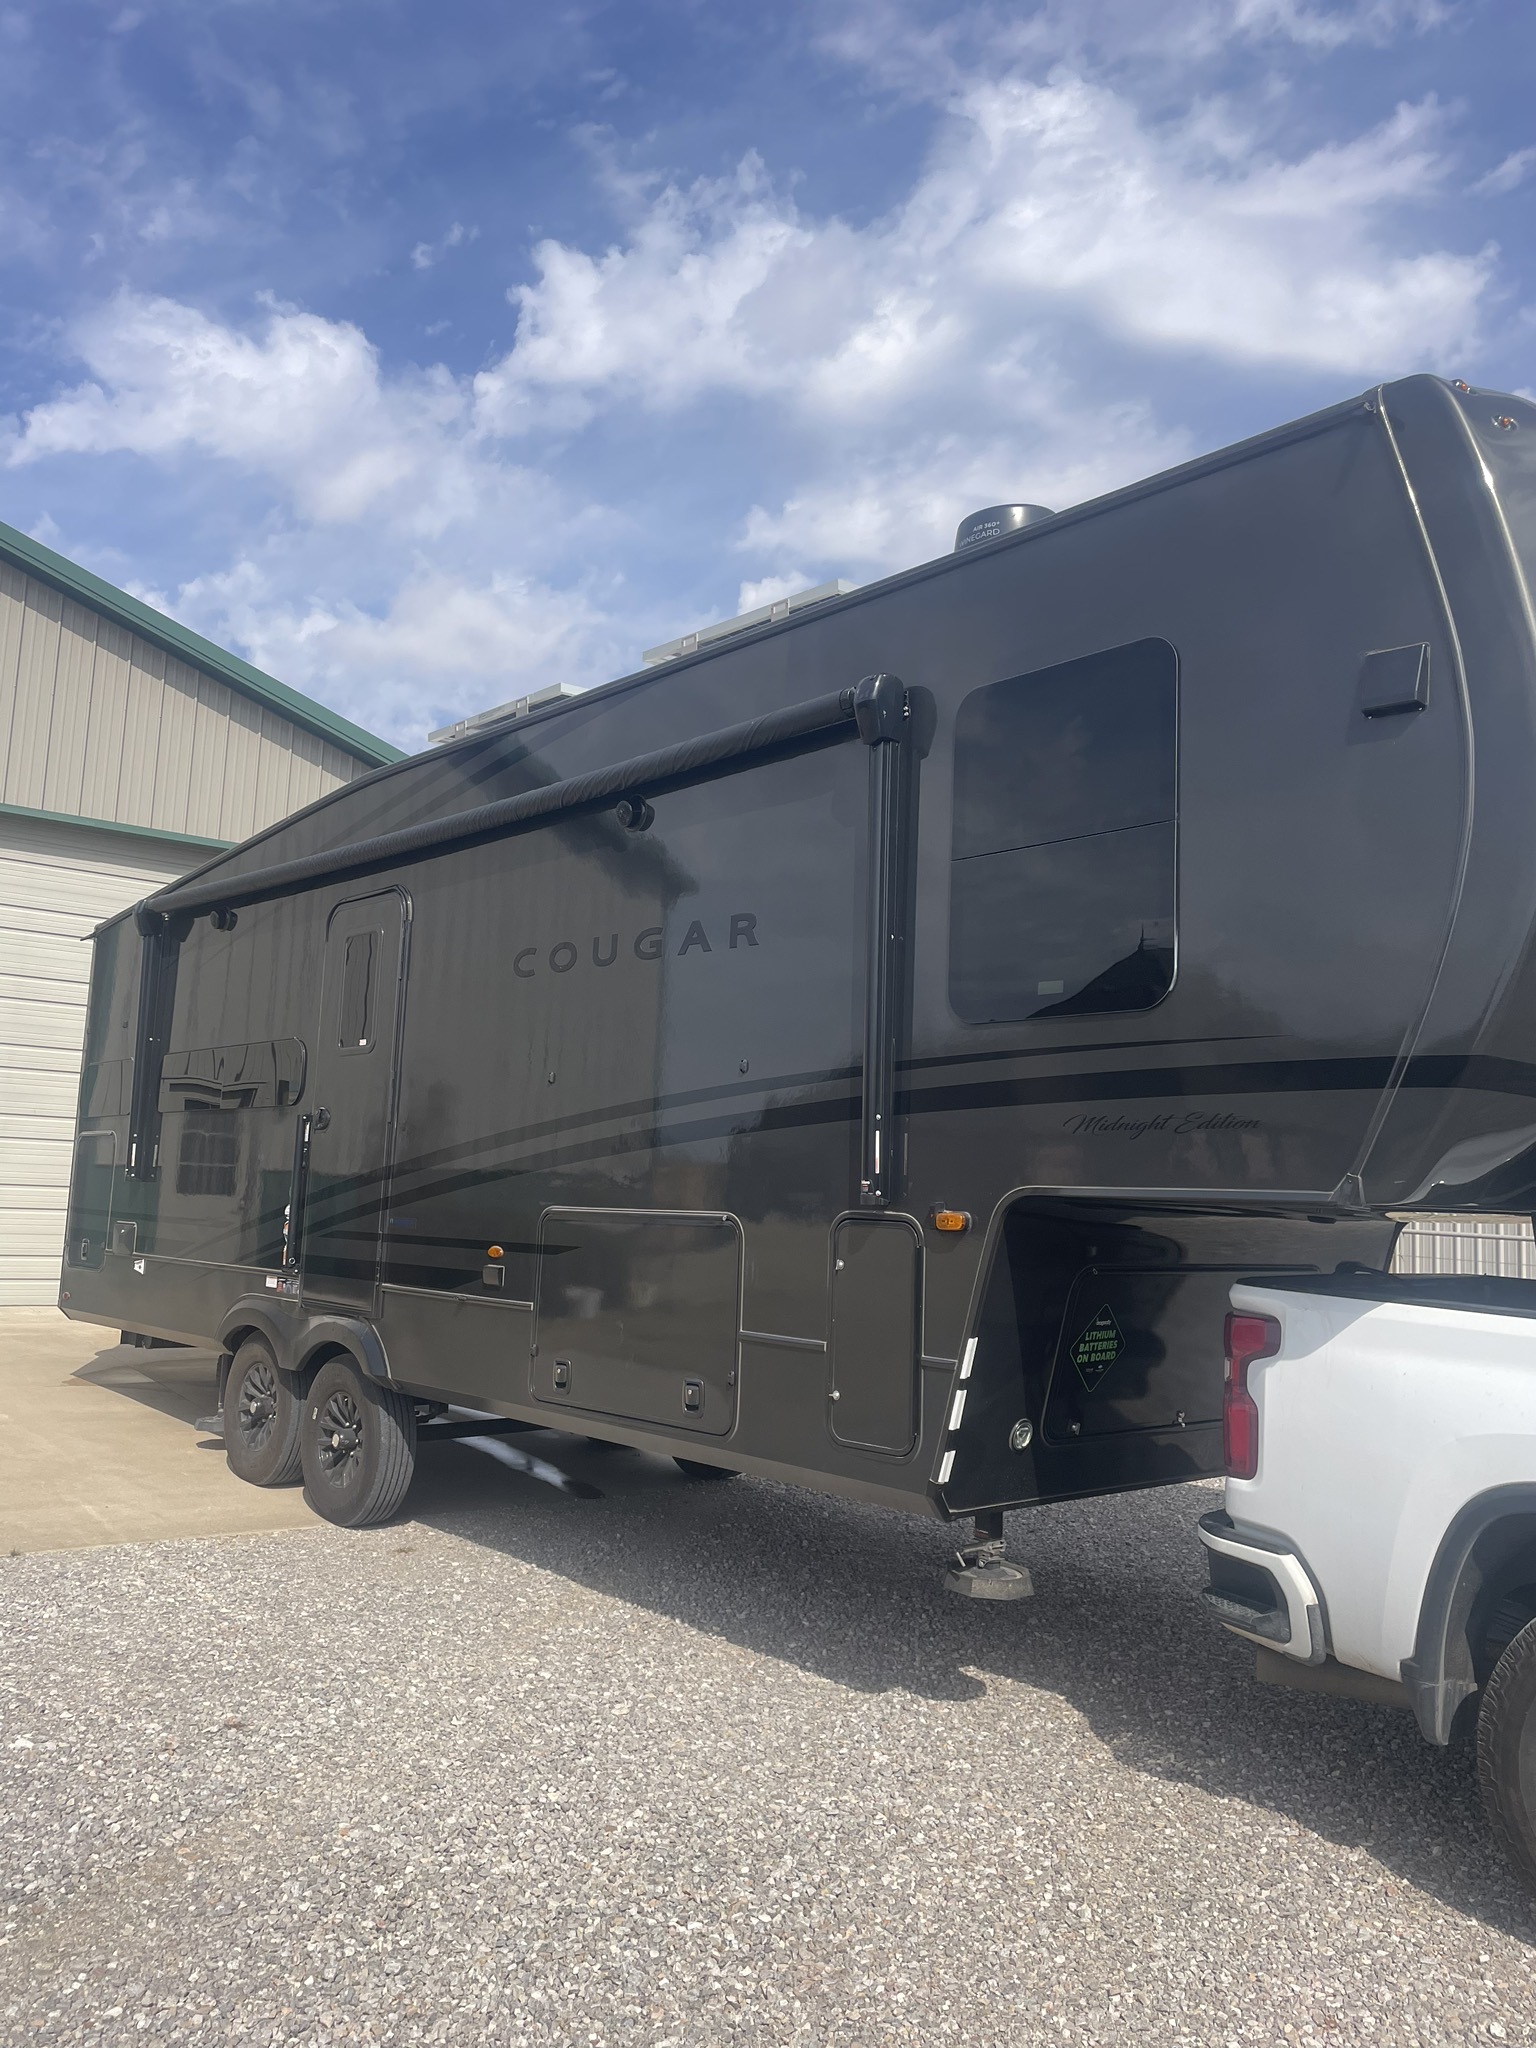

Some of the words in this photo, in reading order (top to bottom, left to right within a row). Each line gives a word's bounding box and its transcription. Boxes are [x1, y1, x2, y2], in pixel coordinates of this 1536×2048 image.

[972, 525, 983, 533] AIR
[512, 912, 760, 979] COUGAR
[1062, 1113, 1175, 1141] Midnight
[1174, 1111, 1264, 1134] Edition
[1085, 1330, 1117, 1341] LITHIUM
[1079, 1340, 1118, 1353] BATTERIES
[1076, 1354, 1089, 1364] ON
[1090, 1351, 1117, 1362] BOARD
